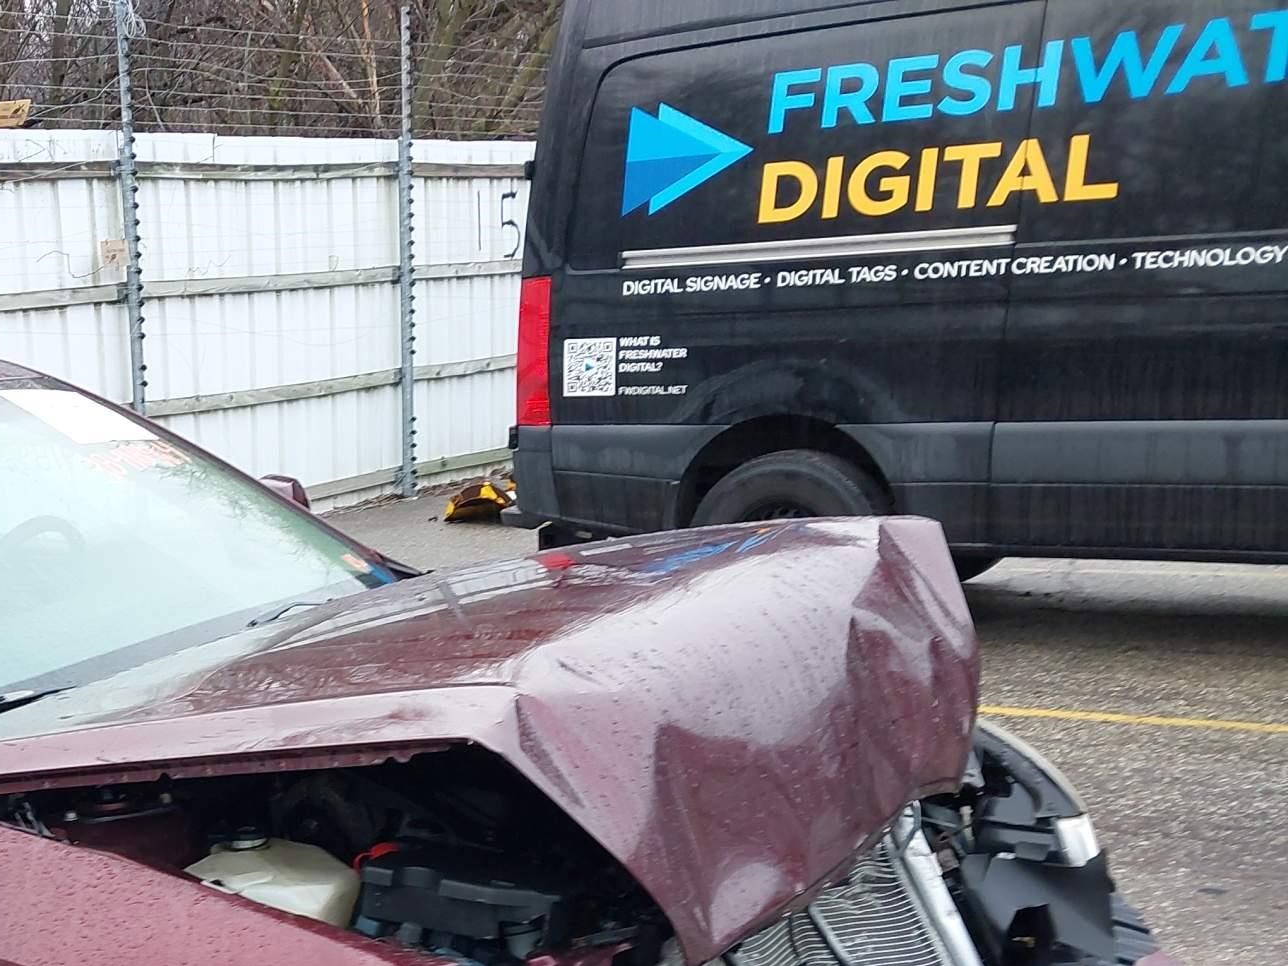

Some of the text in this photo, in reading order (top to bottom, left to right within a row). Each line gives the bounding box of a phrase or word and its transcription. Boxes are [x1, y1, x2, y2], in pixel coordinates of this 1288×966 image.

[758, 134, 1120, 224] DIGITAL
[622, 244, 1288, 296] DIGITAL SIGNAGE DIGITAL TAGS CONTENT CREATION TECHNOLOGY
[618, 335, 661, 348] WHAT IS
[618, 347, 688, 360] FRESHWATER
[618, 361, 664, 373] DIGITAL?
